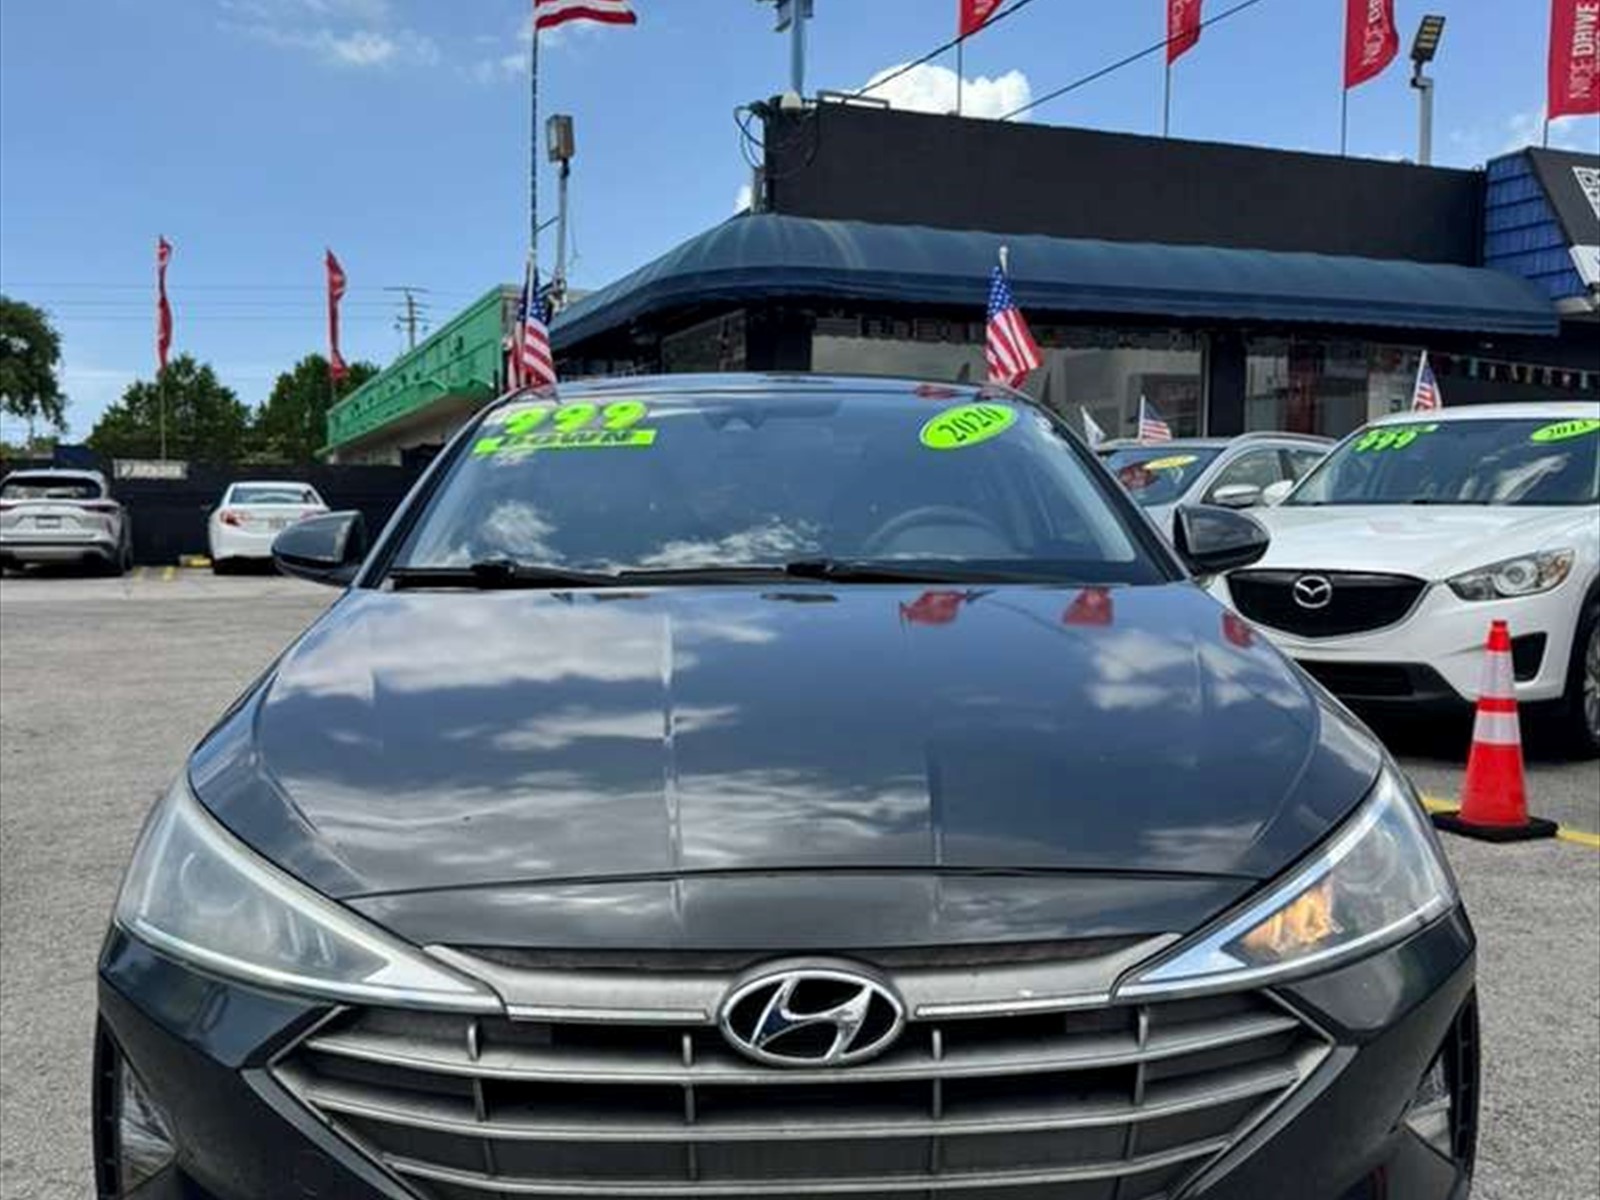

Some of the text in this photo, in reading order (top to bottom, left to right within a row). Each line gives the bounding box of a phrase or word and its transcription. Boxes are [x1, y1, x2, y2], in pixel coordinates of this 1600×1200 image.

[1568, 2, 1600, 99] NICE DRIVE
[504, 401, 647, 434] 999
[938, 405, 1004, 442] 2020
[499, 429, 630, 449] DOWN
